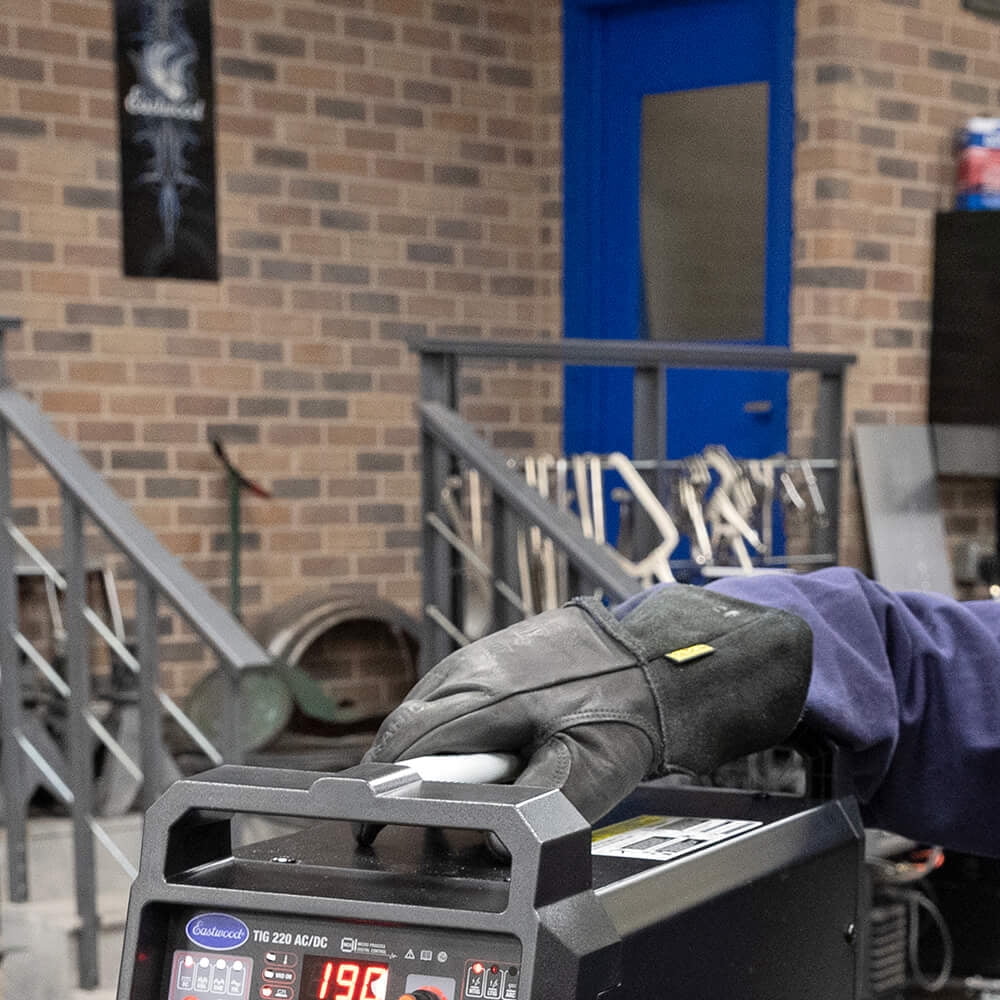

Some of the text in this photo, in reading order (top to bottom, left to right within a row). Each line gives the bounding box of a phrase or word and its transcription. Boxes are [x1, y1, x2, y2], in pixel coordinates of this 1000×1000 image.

[192, 920, 244, 940] Eastwood
[253, 930, 328, 948] TIG 220 AC/DC
